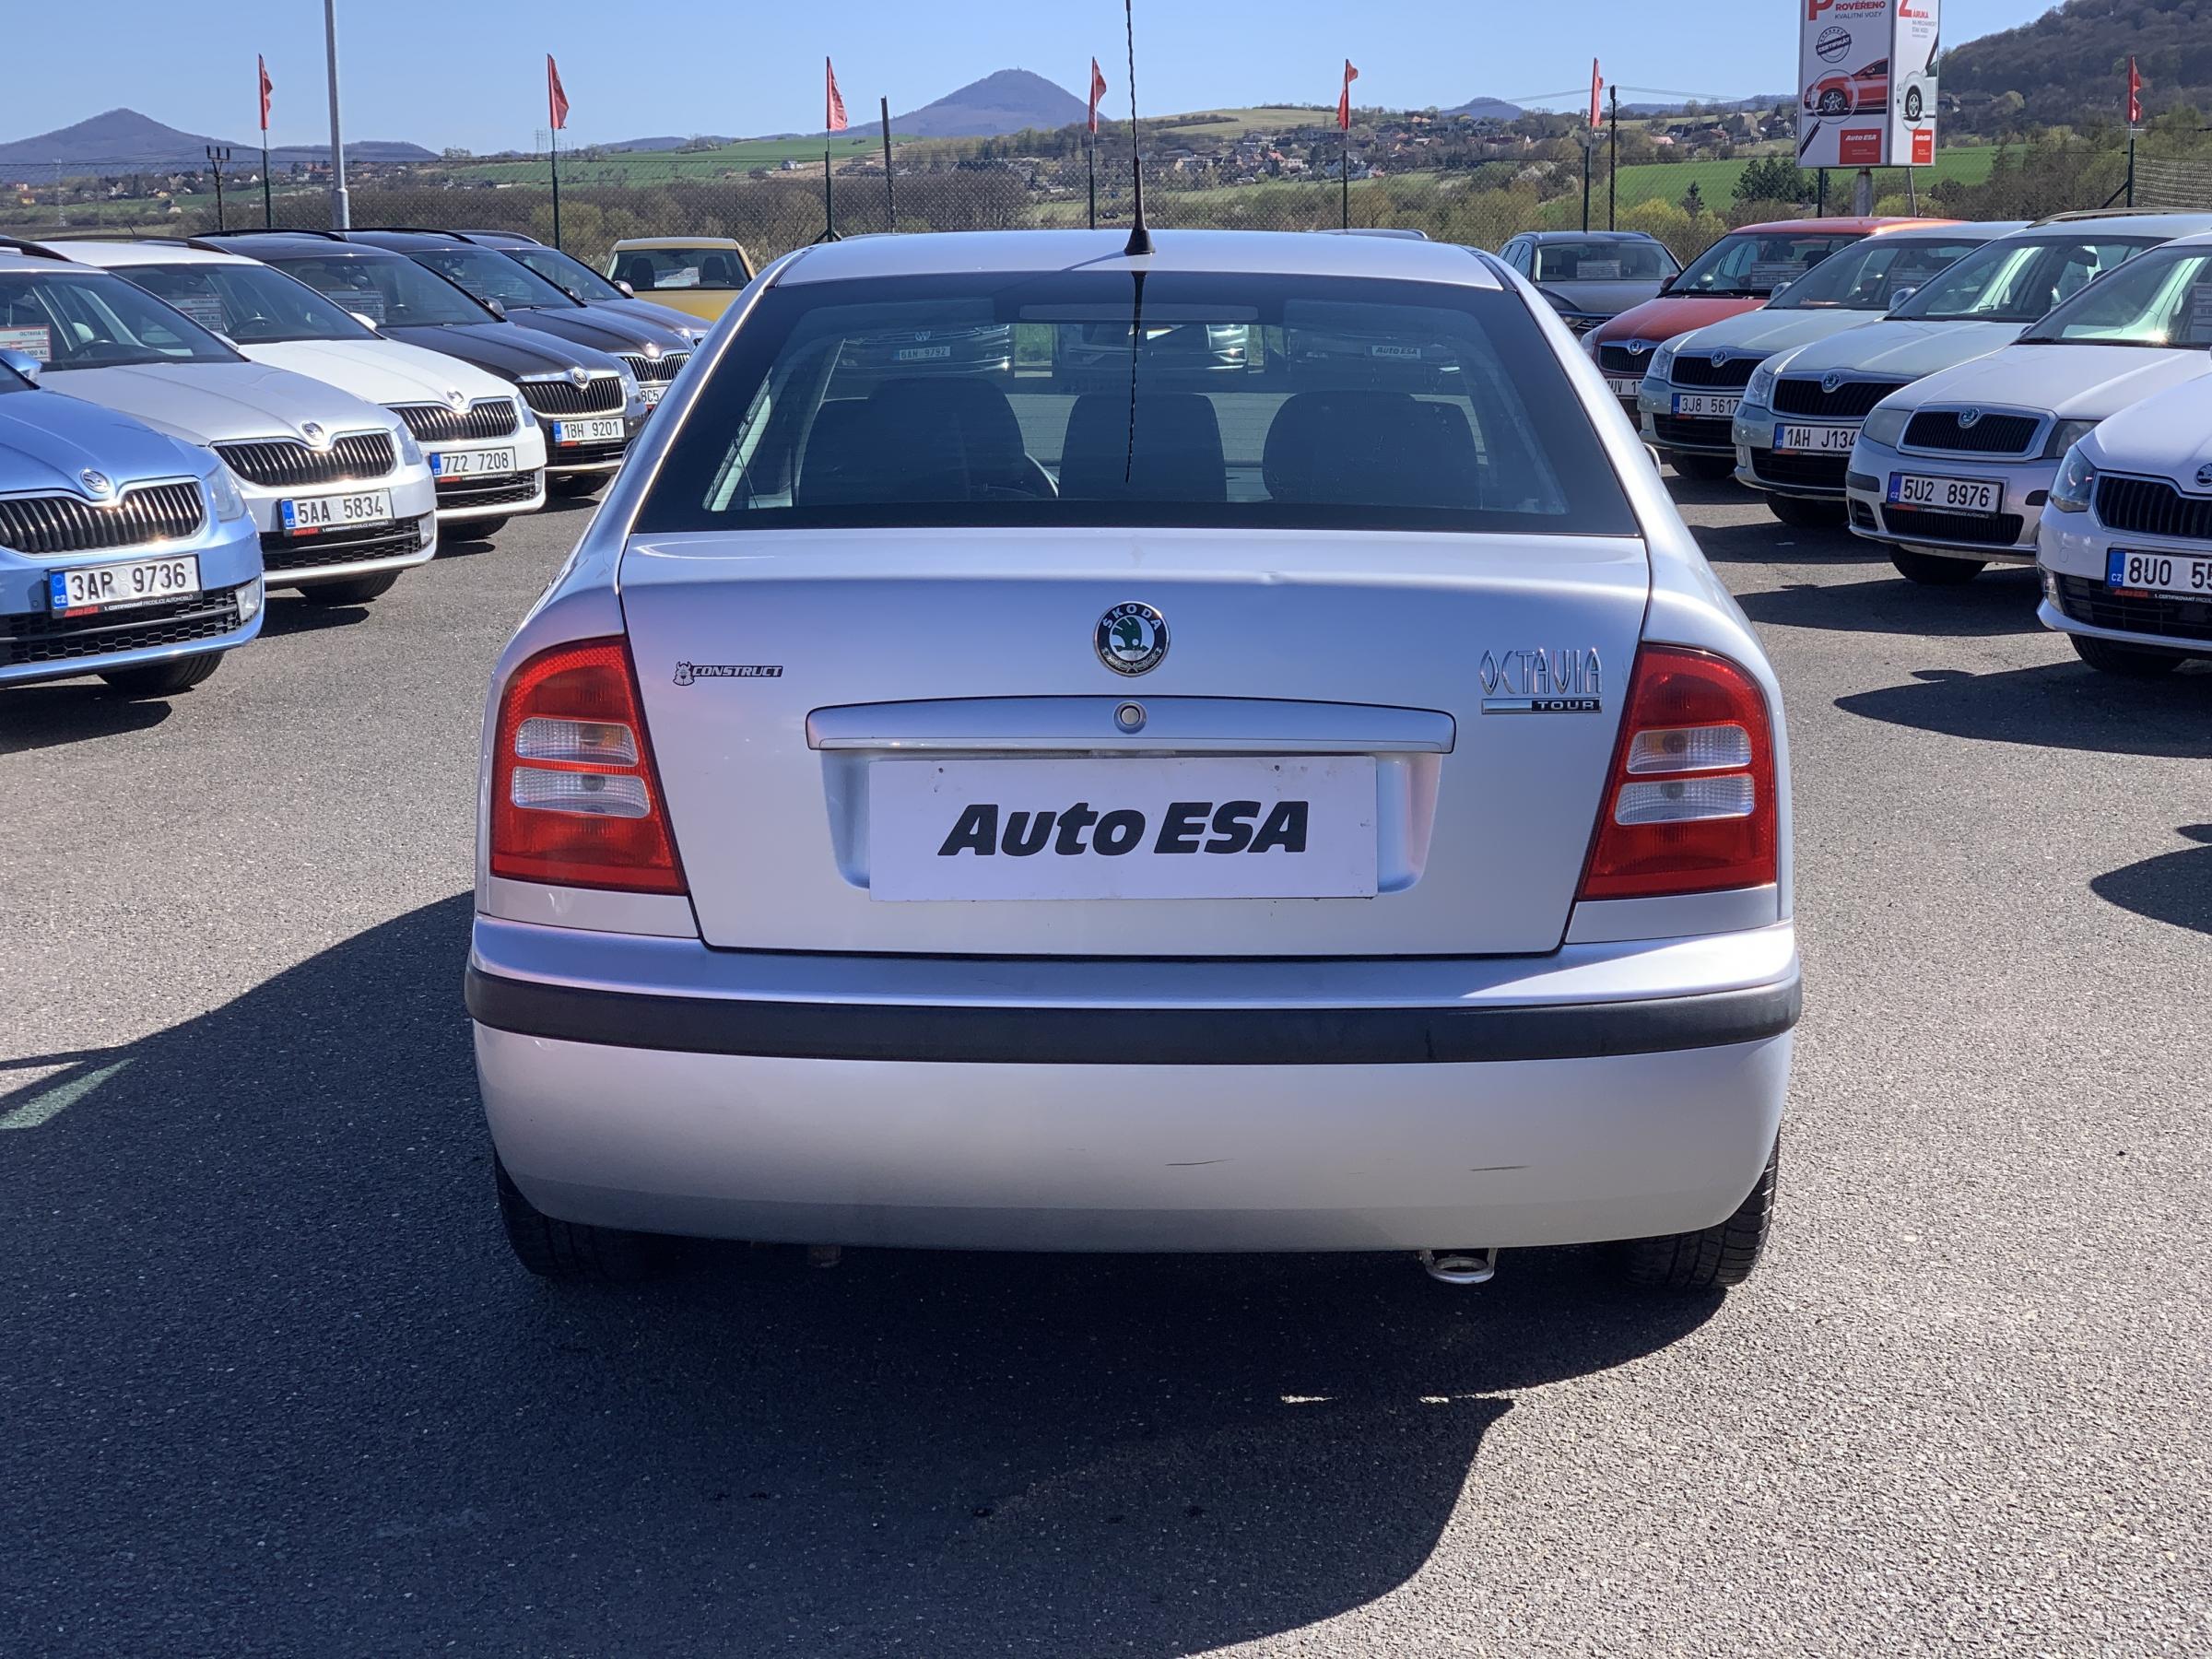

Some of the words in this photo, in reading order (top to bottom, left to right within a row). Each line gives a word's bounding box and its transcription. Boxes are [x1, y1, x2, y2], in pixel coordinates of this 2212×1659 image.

[1834, 11, 1864, 19] KVALITNÍ
[1606, 380, 1623, 394] UV
[1682, 397, 1702, 412] 3J8
[1711, 398, 1740, 414] 5617
[564, 423, 584, 439] 1BH
[592, 420, 619, 437] 9201
[1788, 429, 1811, 447] 1AH
[477, 452, 509, 471] 7208
[1903, 479, 1935, 502] 5U2
[1947, 484, 1991, 508] 8976
[297, 500, 332, 524] 5AA
[343, 495, 384, 519] 5834
[2111, 572, 2123, 582] CZ
[2128, 557, 2172, 586] 8U0
[54, 594, 66, 605] CZ
[71, 571, 113, 600] 3AP
[132, 561, 186, 593] 9736
[691, 665, 782, 677] CONSTRUCT
[1479, 647, 1602, 695] OCTAVIA
[1537, 700, 1594, 711] TOUR
[937, 802, 1147, 857] Auto
[1153, 800, 1309, 854] ESA
